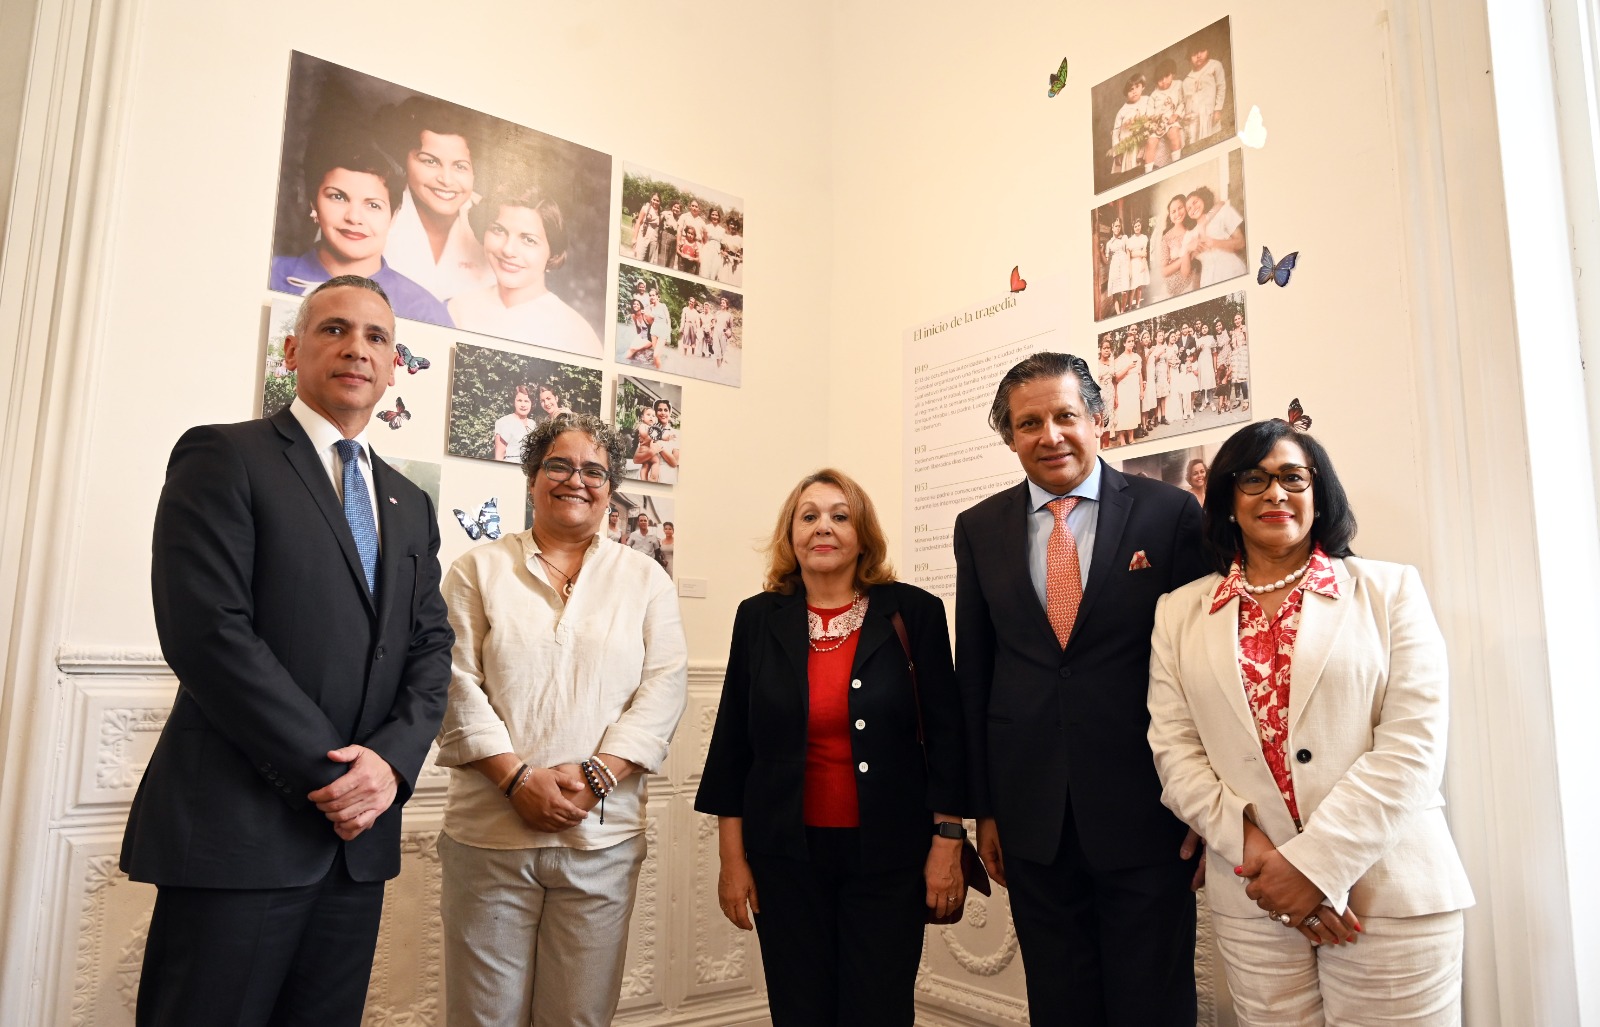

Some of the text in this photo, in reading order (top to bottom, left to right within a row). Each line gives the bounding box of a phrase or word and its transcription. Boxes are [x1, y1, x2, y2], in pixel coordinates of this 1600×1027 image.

[914, 296, 1016, 341] El inicio de la tragedia
[956, 360, 984, 371] autoridades
[997, 349, 1015, 358] ciudad
[980, 372, 999, 380] Mirabal
[948, 399, 967, 407] semana
[954, 485, 987, 495] consecuencia
